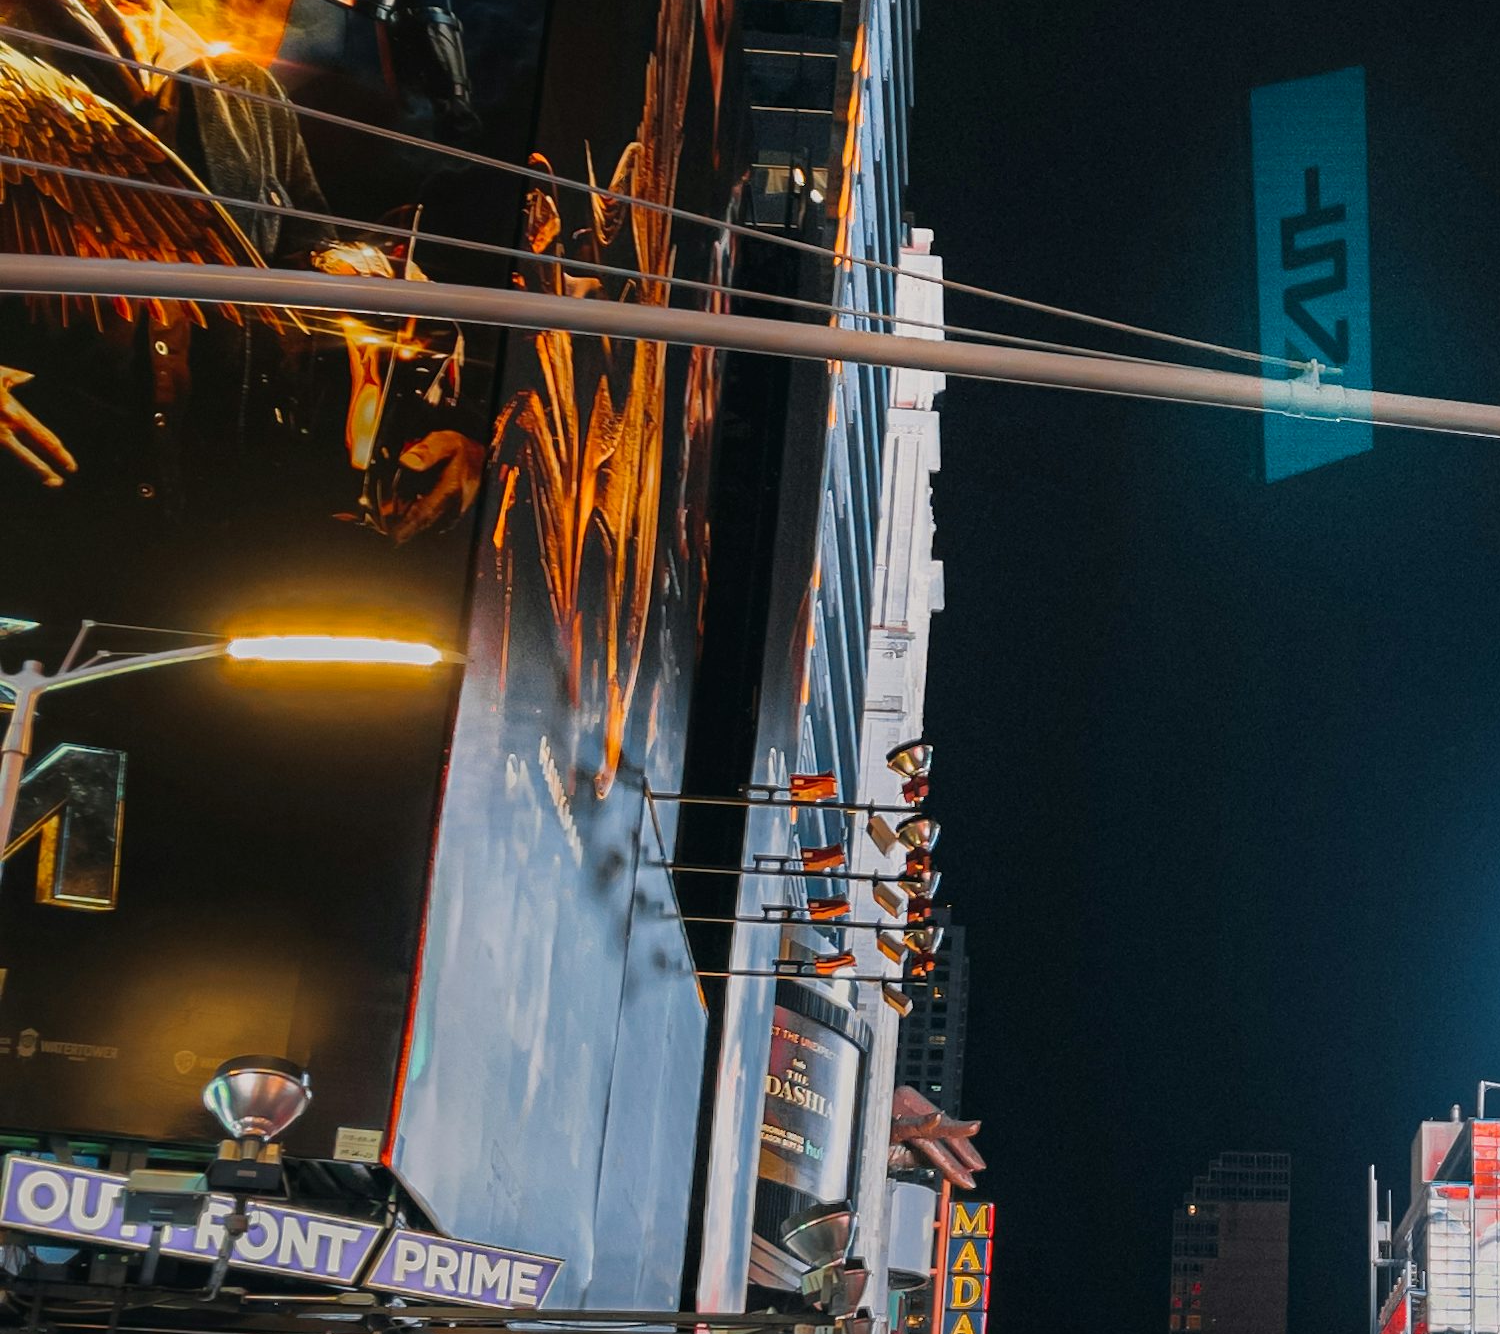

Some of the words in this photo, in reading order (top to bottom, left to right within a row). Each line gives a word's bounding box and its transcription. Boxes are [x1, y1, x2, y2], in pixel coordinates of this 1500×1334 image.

[786, 1068, 809, 1086] THE
[17, 1169, 362, 1276] OURONT
[396, 1240, 539, 1307] PRIME
